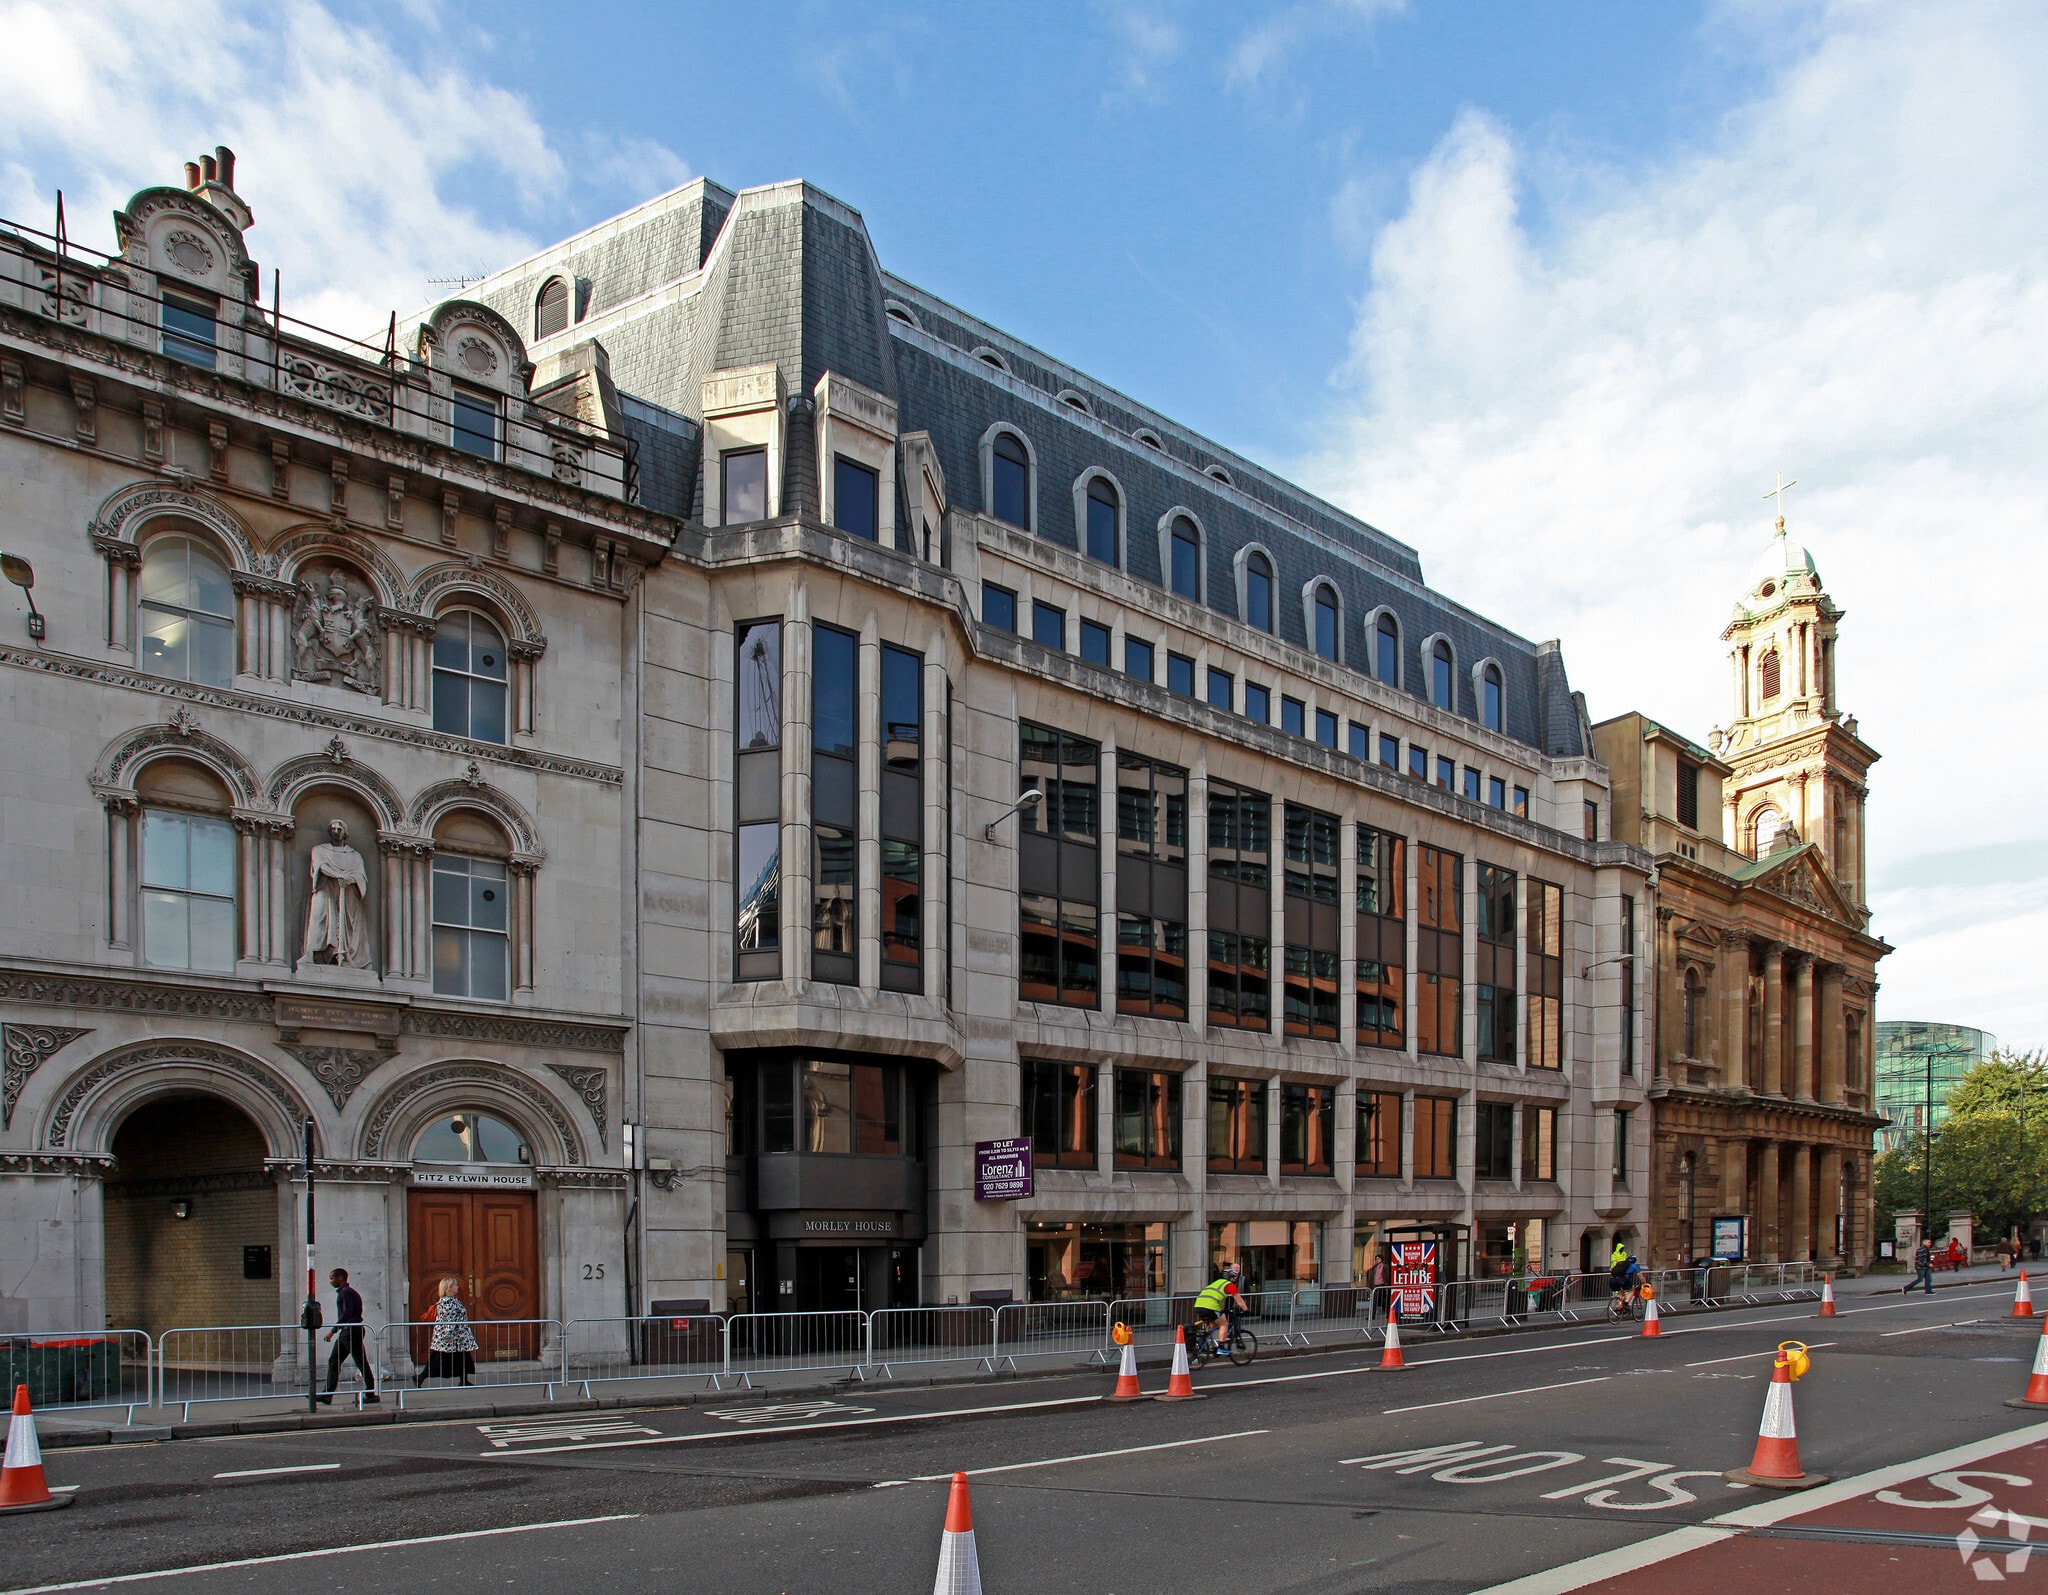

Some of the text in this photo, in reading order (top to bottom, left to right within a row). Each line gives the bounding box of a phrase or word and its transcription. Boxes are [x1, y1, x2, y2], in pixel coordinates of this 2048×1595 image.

[1002, 1140, 1014, 1148] LET
[982, 1164, 1014, 1176] Lorenz
[418, 1174, 527, 1184] FITZ EYLWIN HOUSE
[995, 1182, 1008, 1190] 7629
[805, 1221, 892, 1231] MORLEY HOUSE
[582, 1263, 605, 1280] 25
[1393, 1269, 1432, 1284] LET IT BE
[1338, 1440, 1749, 1511] SLOW
